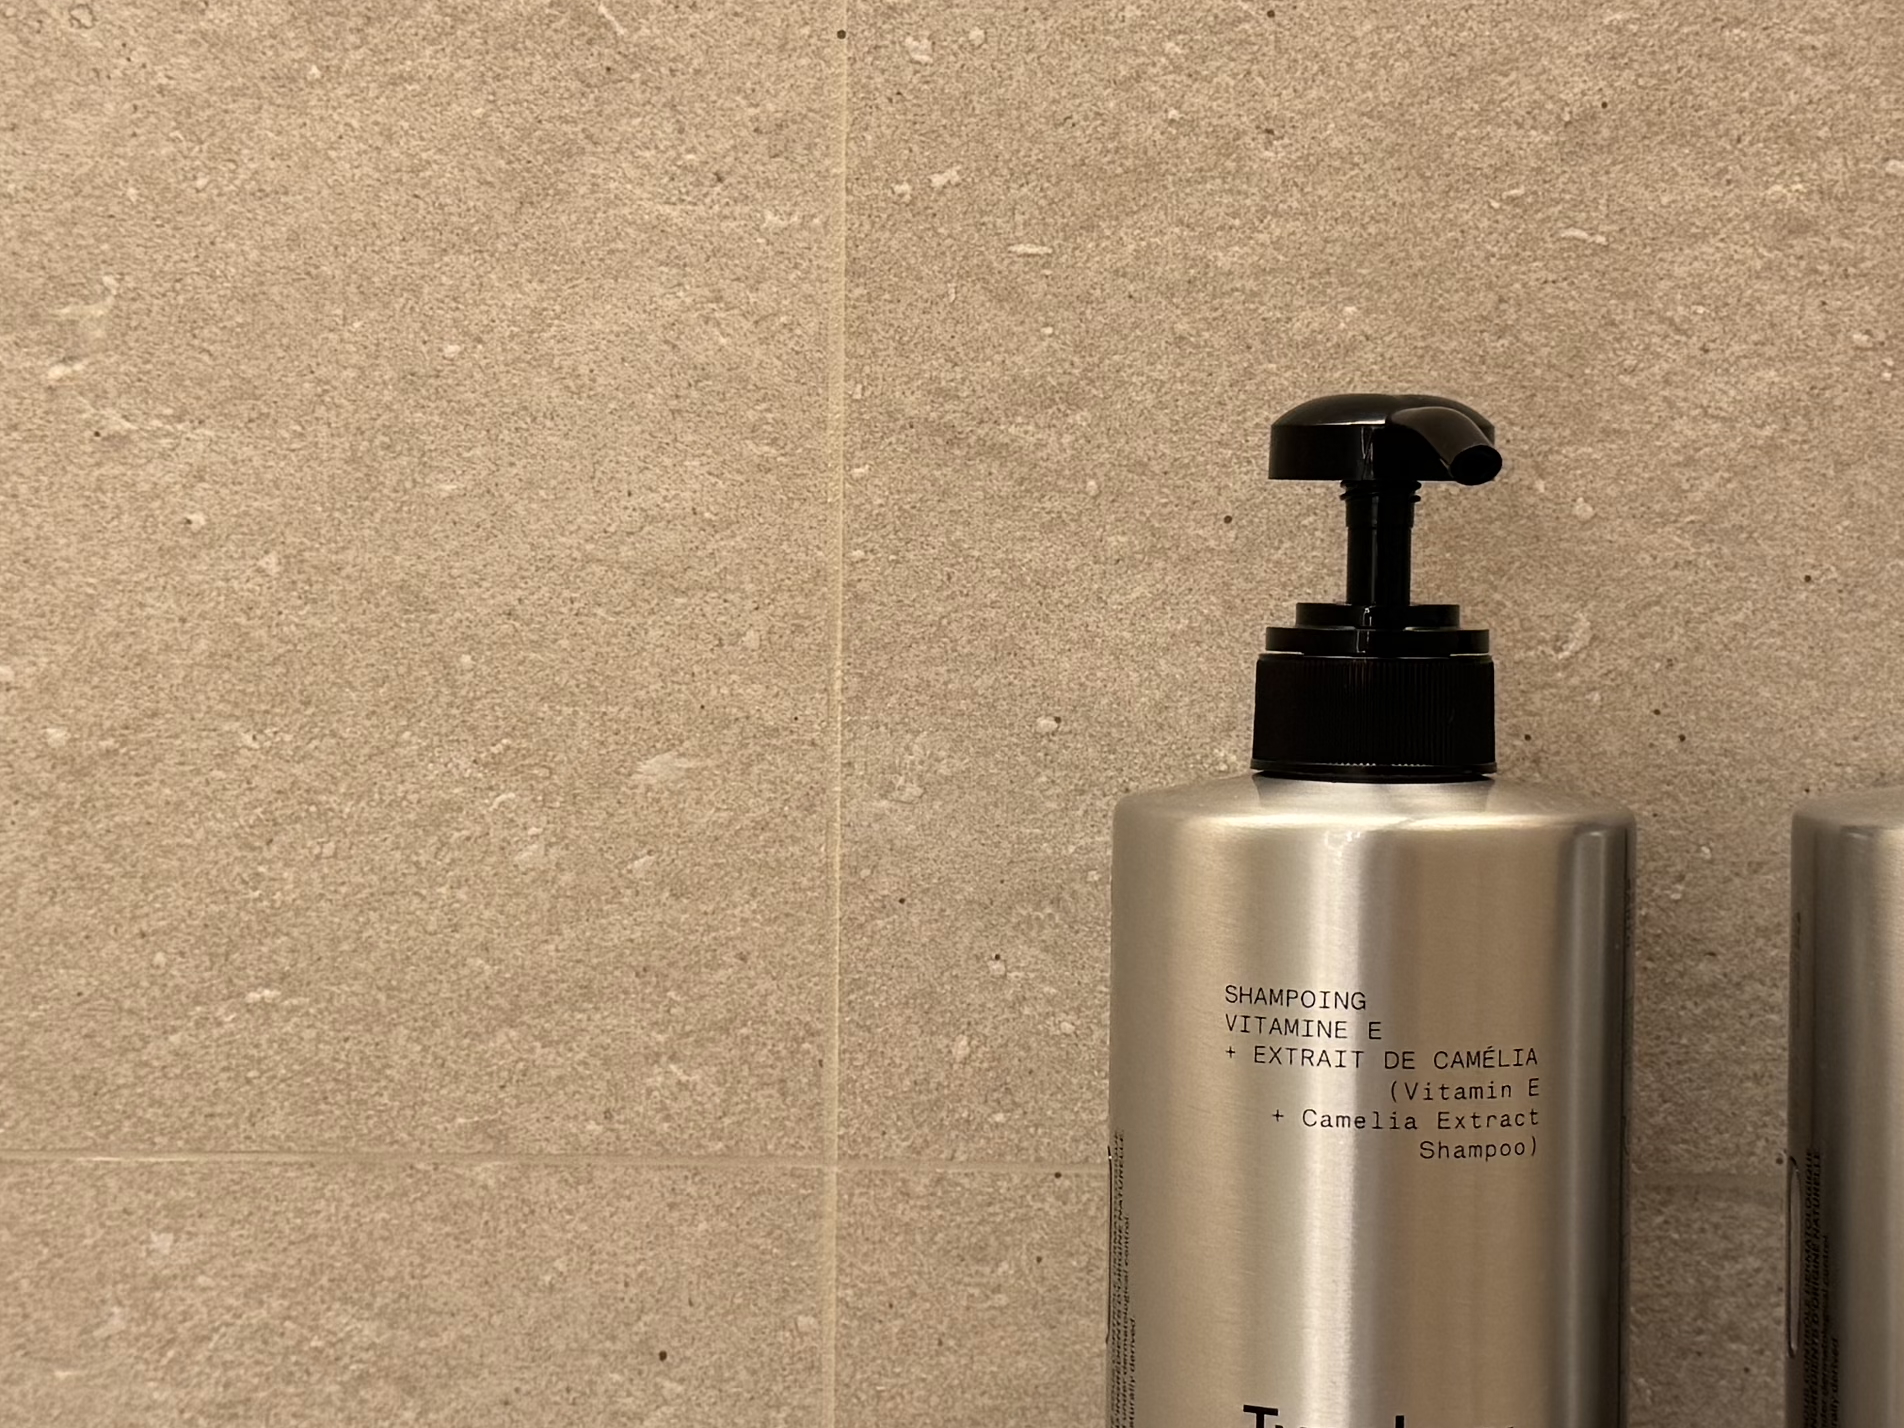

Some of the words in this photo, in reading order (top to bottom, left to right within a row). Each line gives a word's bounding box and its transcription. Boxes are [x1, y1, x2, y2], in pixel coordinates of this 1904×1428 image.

[1225, 985, 1366, 1010] SHAMPOING
[1225, 1013, 1347, 1039] VITAMINE
[1368, 1021, 1382, 1040] E
[1254, 1045, 1365, 1069] EXTRAIT
[1384, 1051, 1416, 1069] DE
[1433, 1046, 1538, 1069] CAMÉLIA
[1390, 1080, 1512, 1103] (Vitamin
[1528, 1078, 1540, 1096] E
[1302, 1109, 1417, 1130] Camelia
[1437, 1108, 1539, 1130] Extract
[1420, 1136, 1536, 1161] Shampoo)
